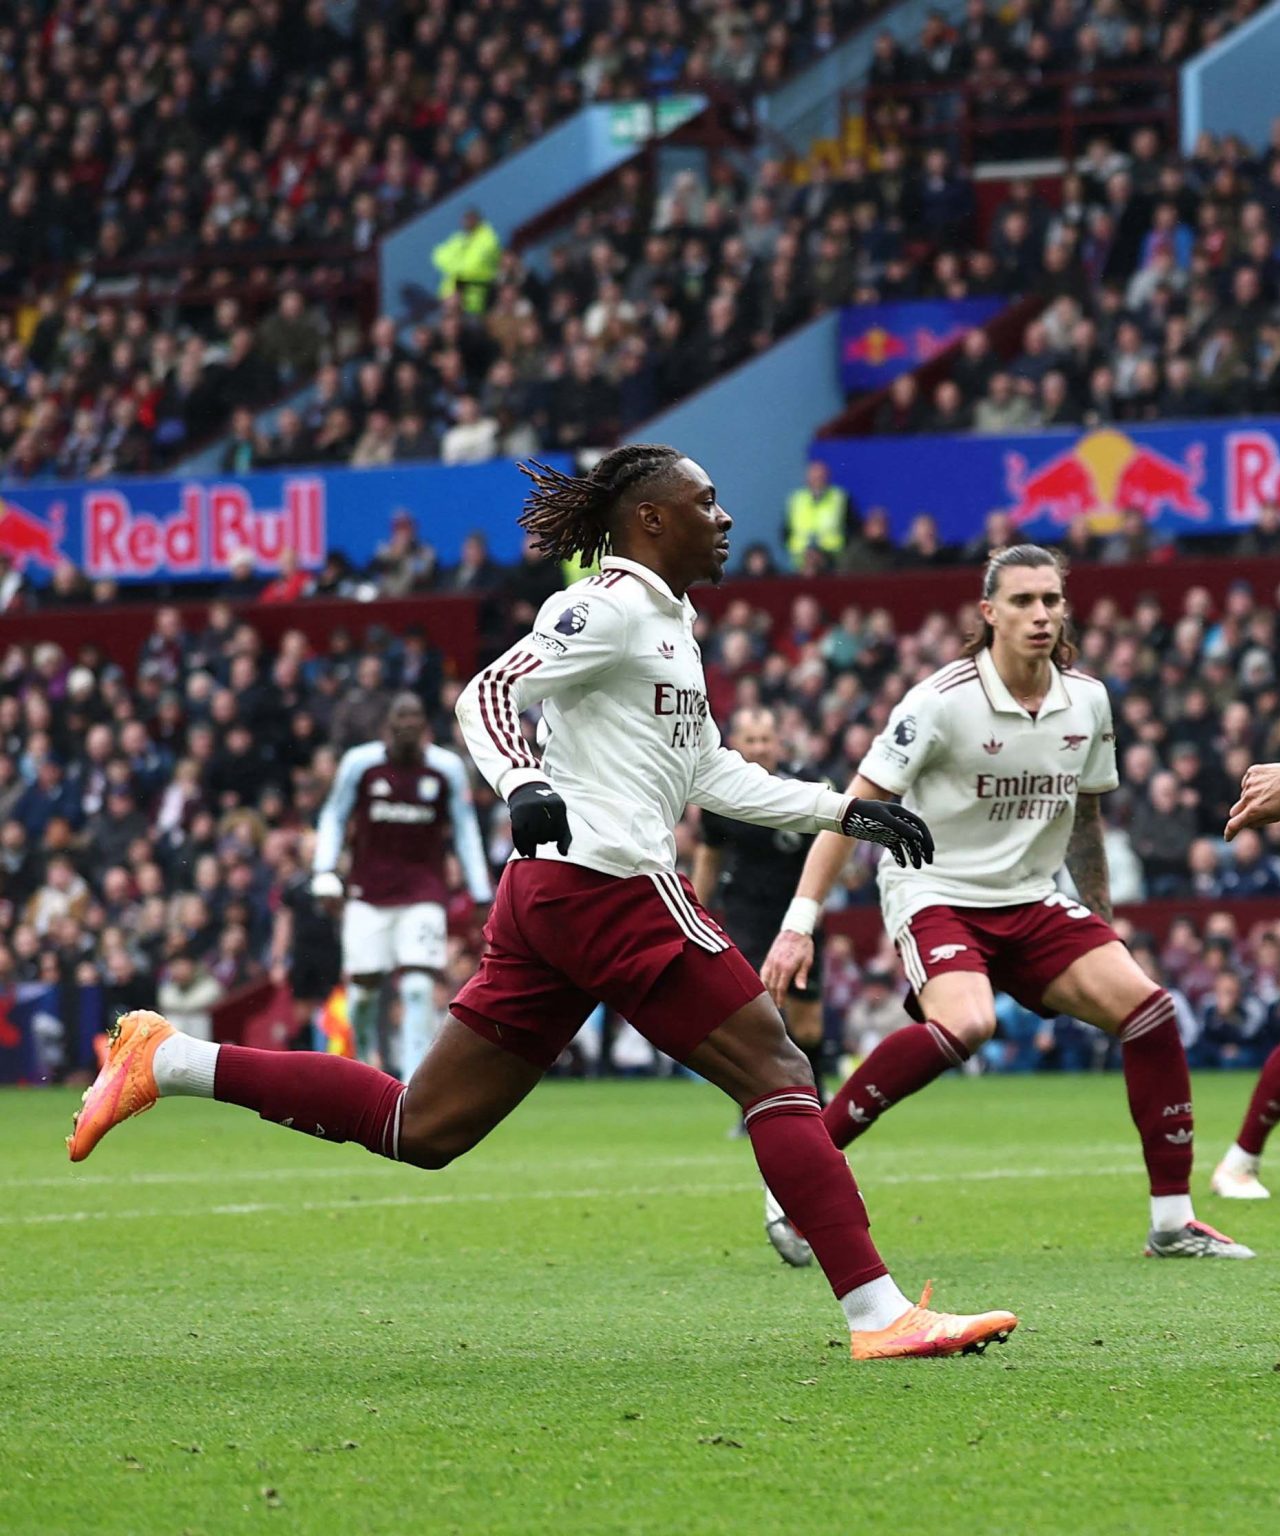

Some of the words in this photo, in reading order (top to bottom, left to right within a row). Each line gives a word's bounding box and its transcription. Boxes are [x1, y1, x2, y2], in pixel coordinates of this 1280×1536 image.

[85, 483, 203, 579] Red
[206, 473, 325, 572] Bull
[988, 801, 1016, 821] FLY
